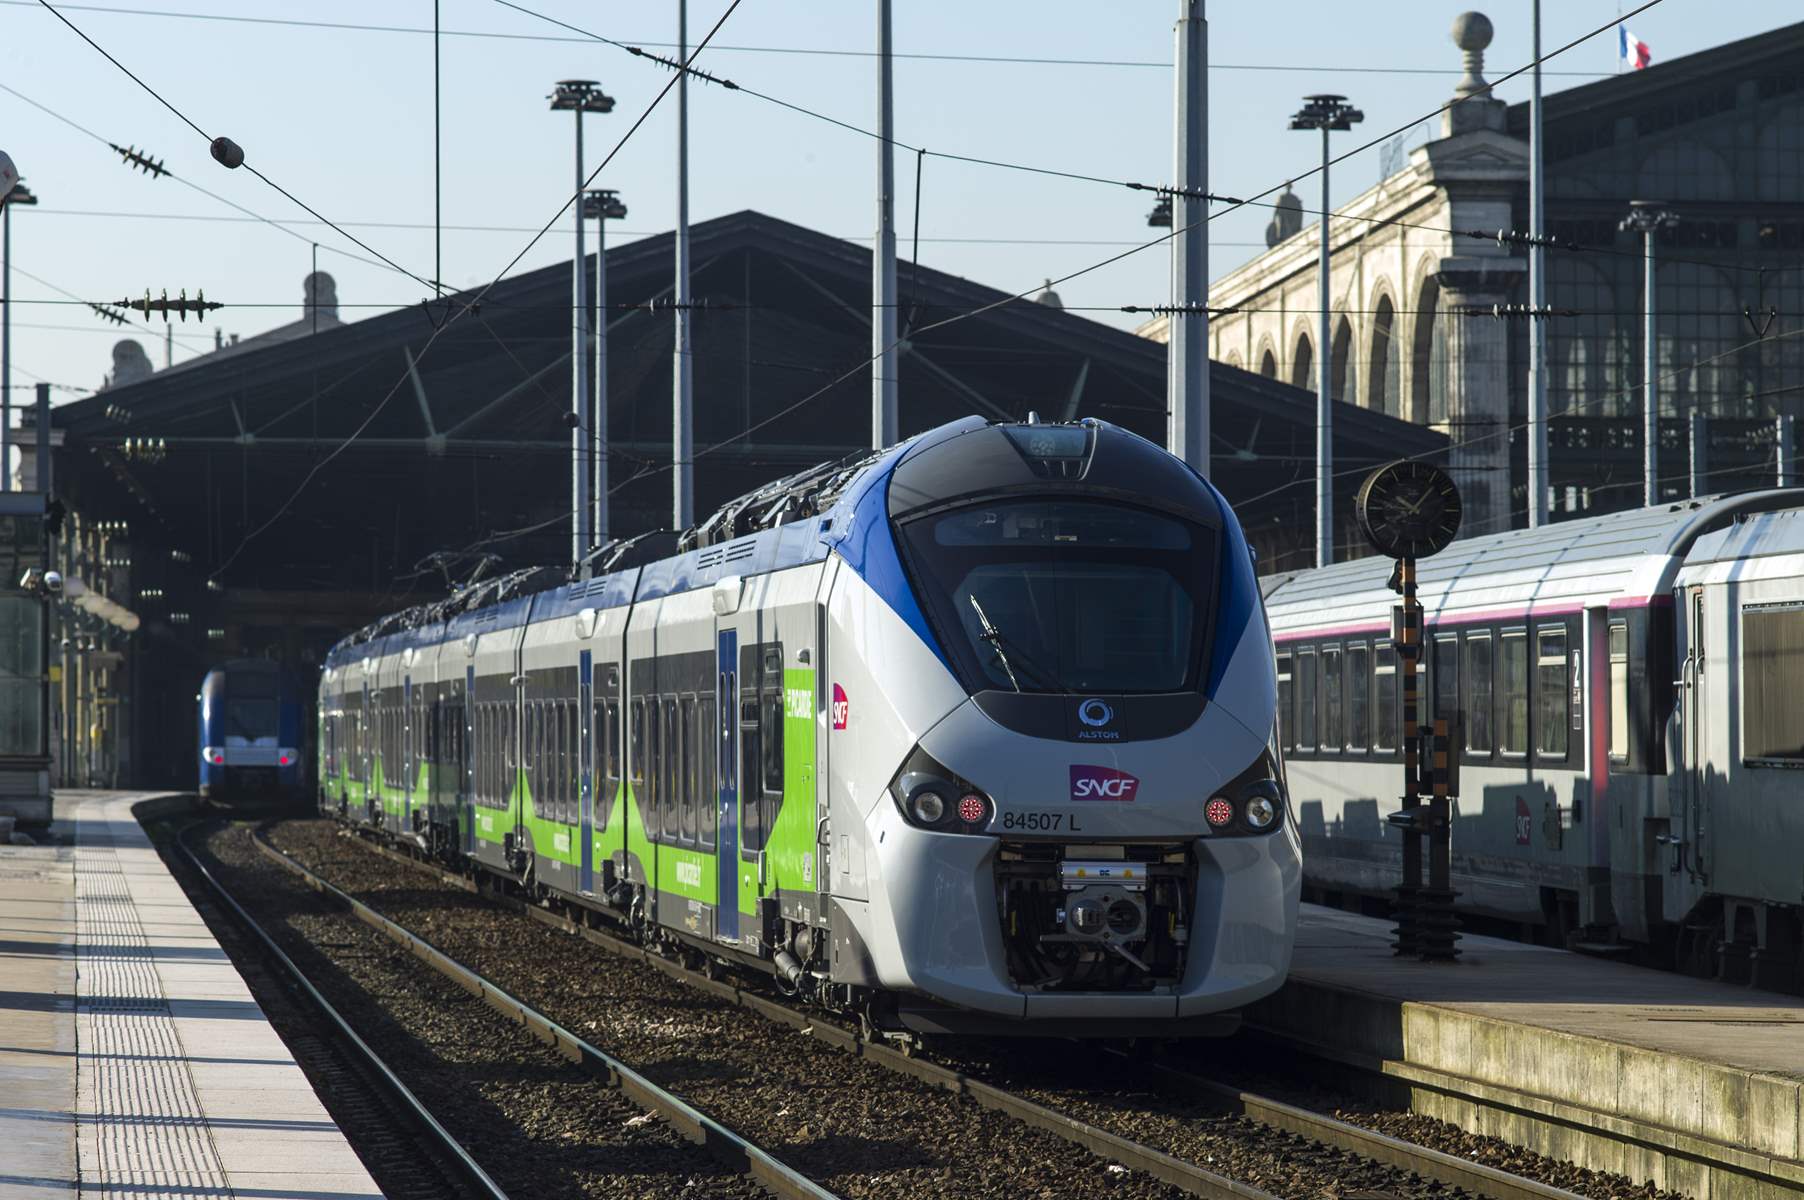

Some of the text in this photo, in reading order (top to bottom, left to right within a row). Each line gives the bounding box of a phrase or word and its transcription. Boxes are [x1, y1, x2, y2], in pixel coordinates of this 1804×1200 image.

[1074, 779, 1135, 797] SNCF
[1003, 812, 1081, 831] 84507 L
